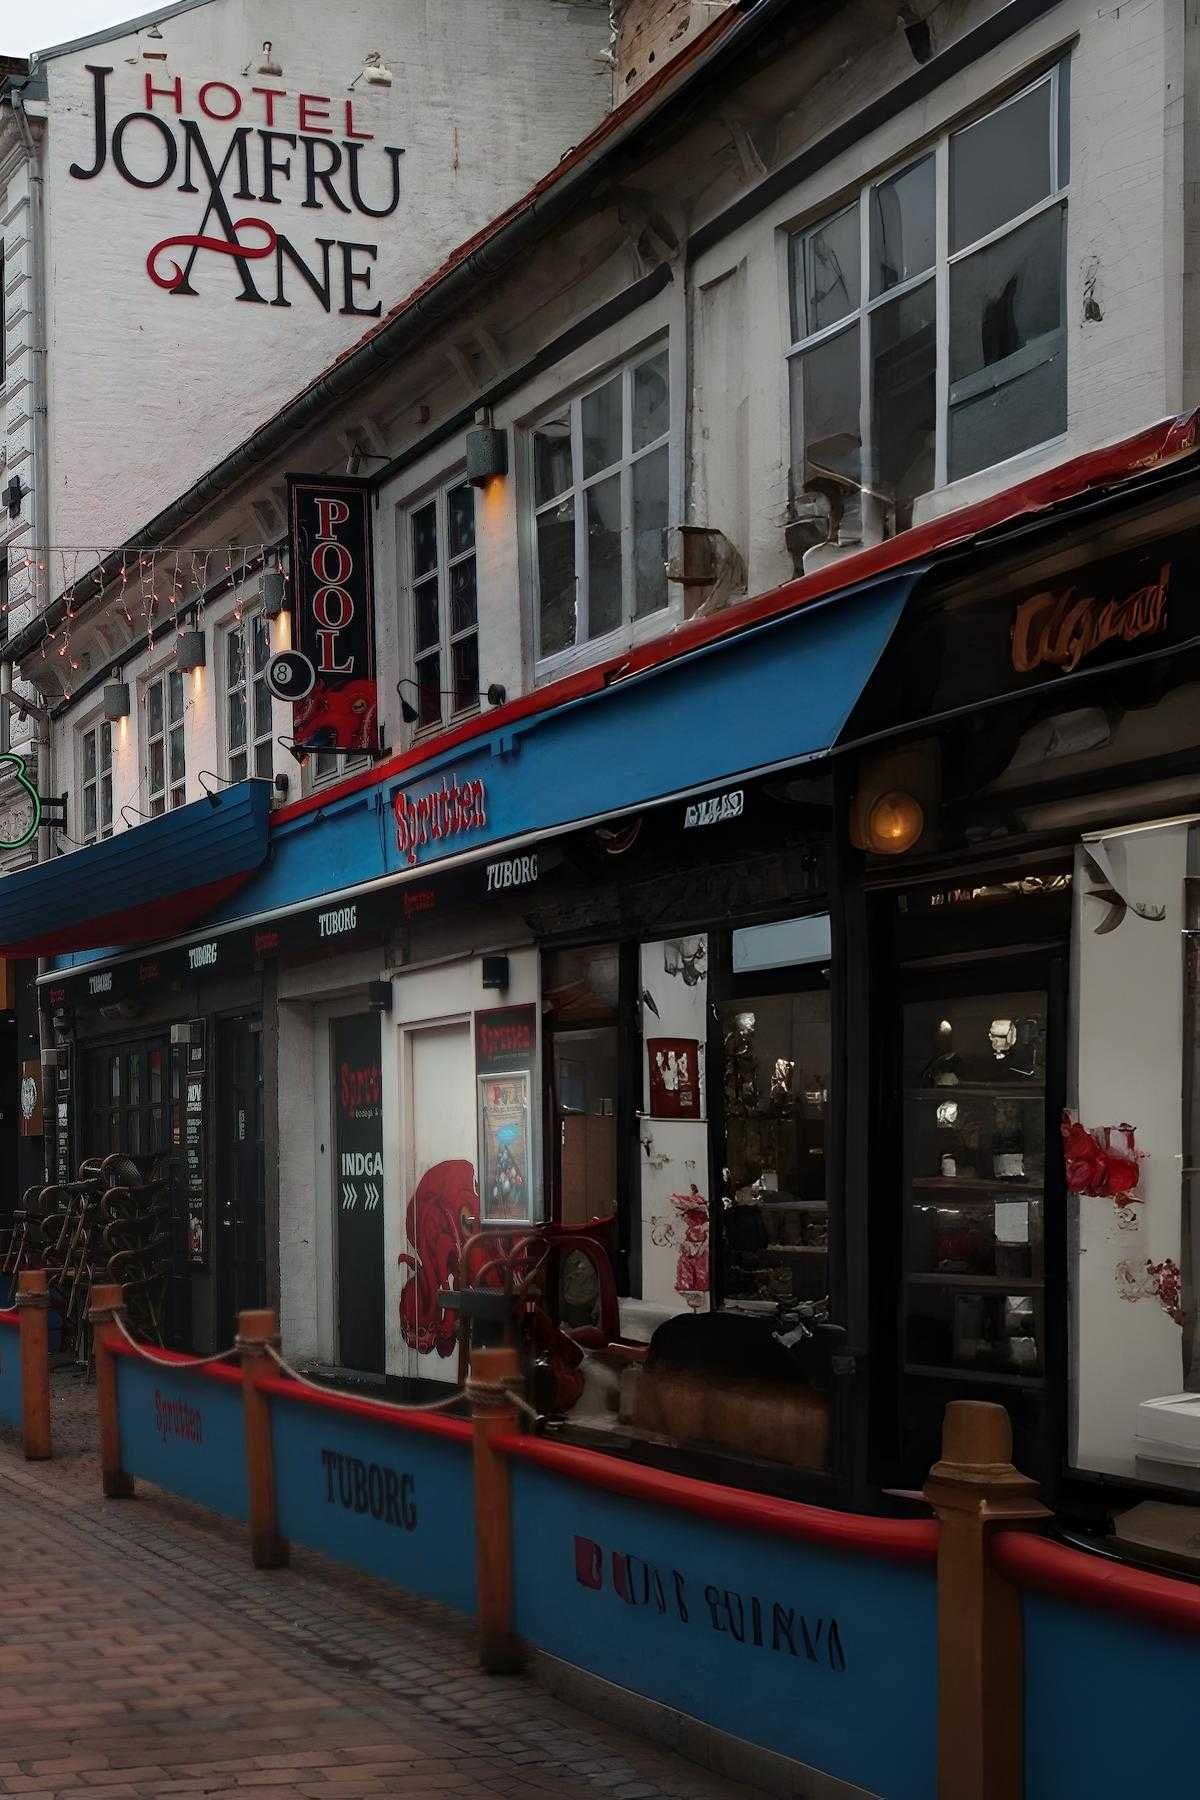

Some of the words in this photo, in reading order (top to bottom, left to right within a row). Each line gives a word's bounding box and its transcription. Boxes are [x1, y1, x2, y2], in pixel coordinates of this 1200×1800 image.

[144, 72, 375, 139] HOTEL
[310, 497, 355, 674] POOL
[276, 663, 288, 683] 8
[485, 854, 539, 892] TUBORG
[318, 905, 358, 937] TUBORG
[188, 942, 218, 970] TUBORG
[321, 1448, 418, 1533] TUBORG
